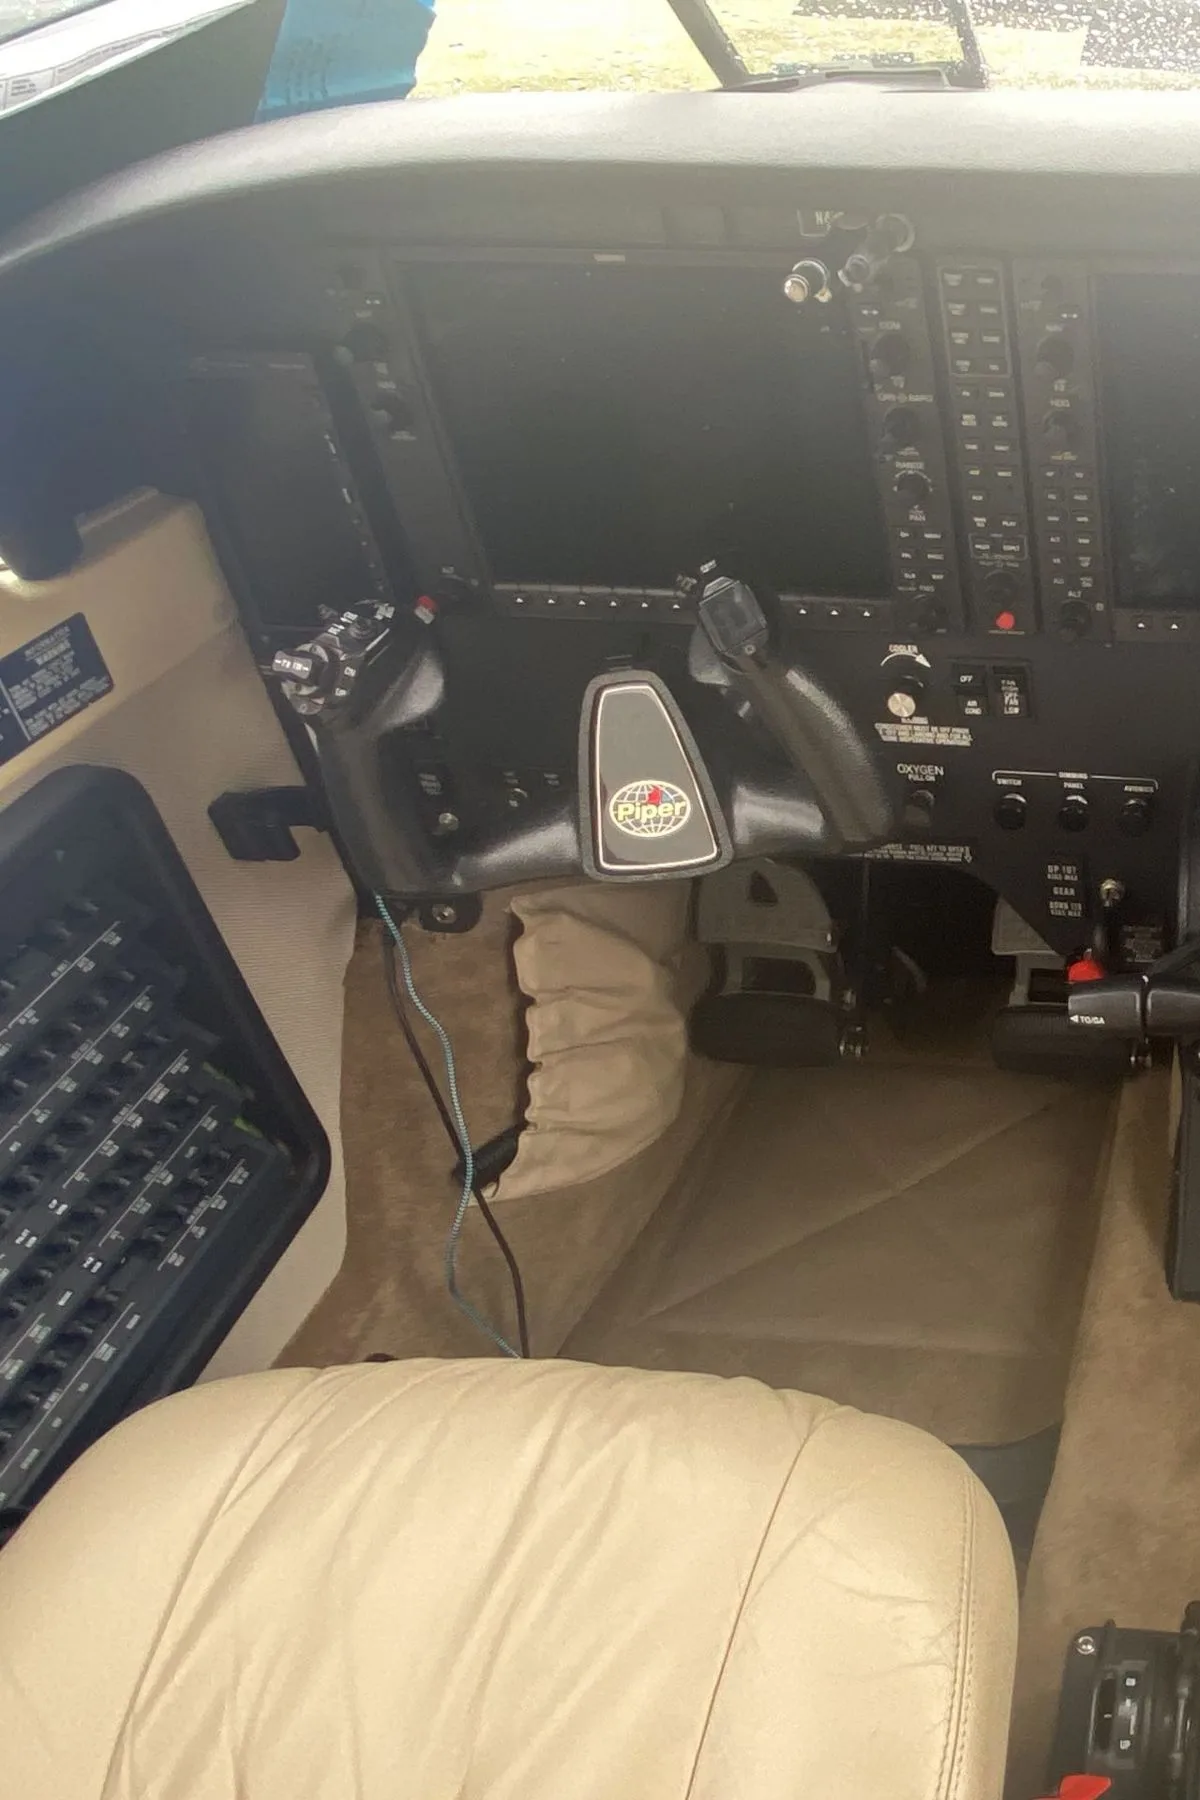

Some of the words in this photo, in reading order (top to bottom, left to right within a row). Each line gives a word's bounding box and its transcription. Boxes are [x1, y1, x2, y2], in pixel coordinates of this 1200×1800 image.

[897, 764, 944, 775] OXYGEN
[618, 800, 686, 825] Piper
[1048, 865, 1059, 873] UP
[1053, 887, 1075, 896] GEAR
[1080, 1016, 1105, 1025] TO/GA
